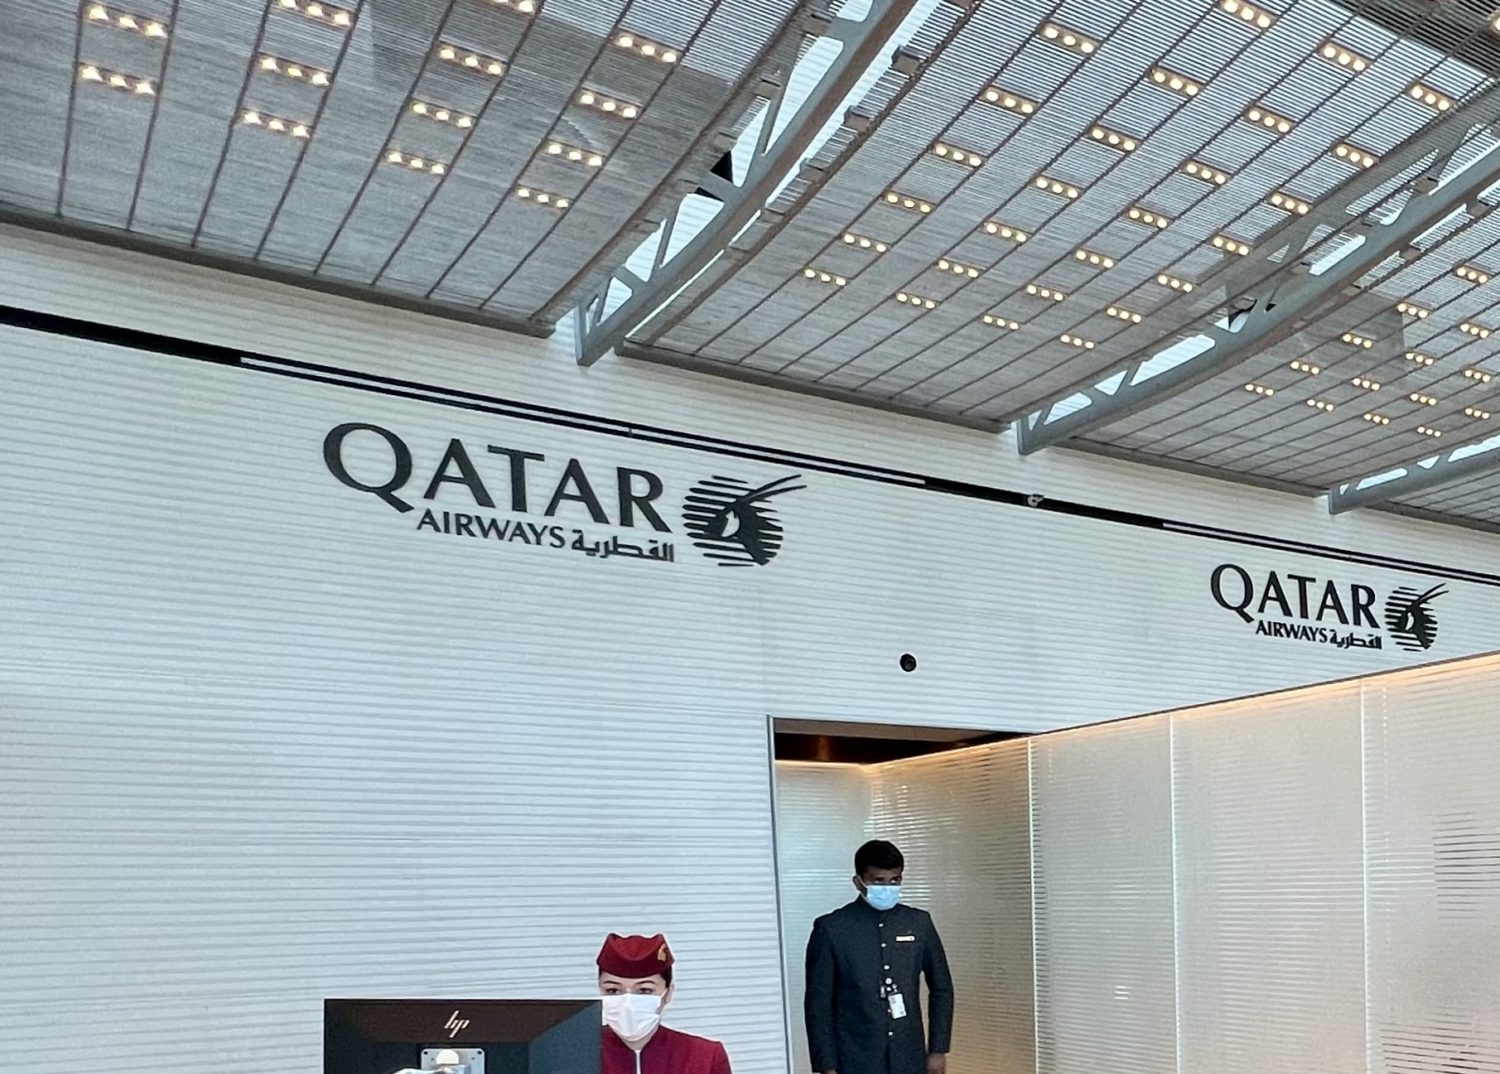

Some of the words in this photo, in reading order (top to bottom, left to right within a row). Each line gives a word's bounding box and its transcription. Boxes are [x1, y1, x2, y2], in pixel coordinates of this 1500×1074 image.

[322, 422, 673, 533] QATAR
[416, 507, 566, 549] AIRWAYS
[570, 528, 675, 563] القطرية
[1210, 563, 1380, 629] QATAR
[1255, 619, 1328, 644] AIRWAYS
[1329, 628, 1382, 650] القطرية
[443, 1009, 470, 1038] hp
